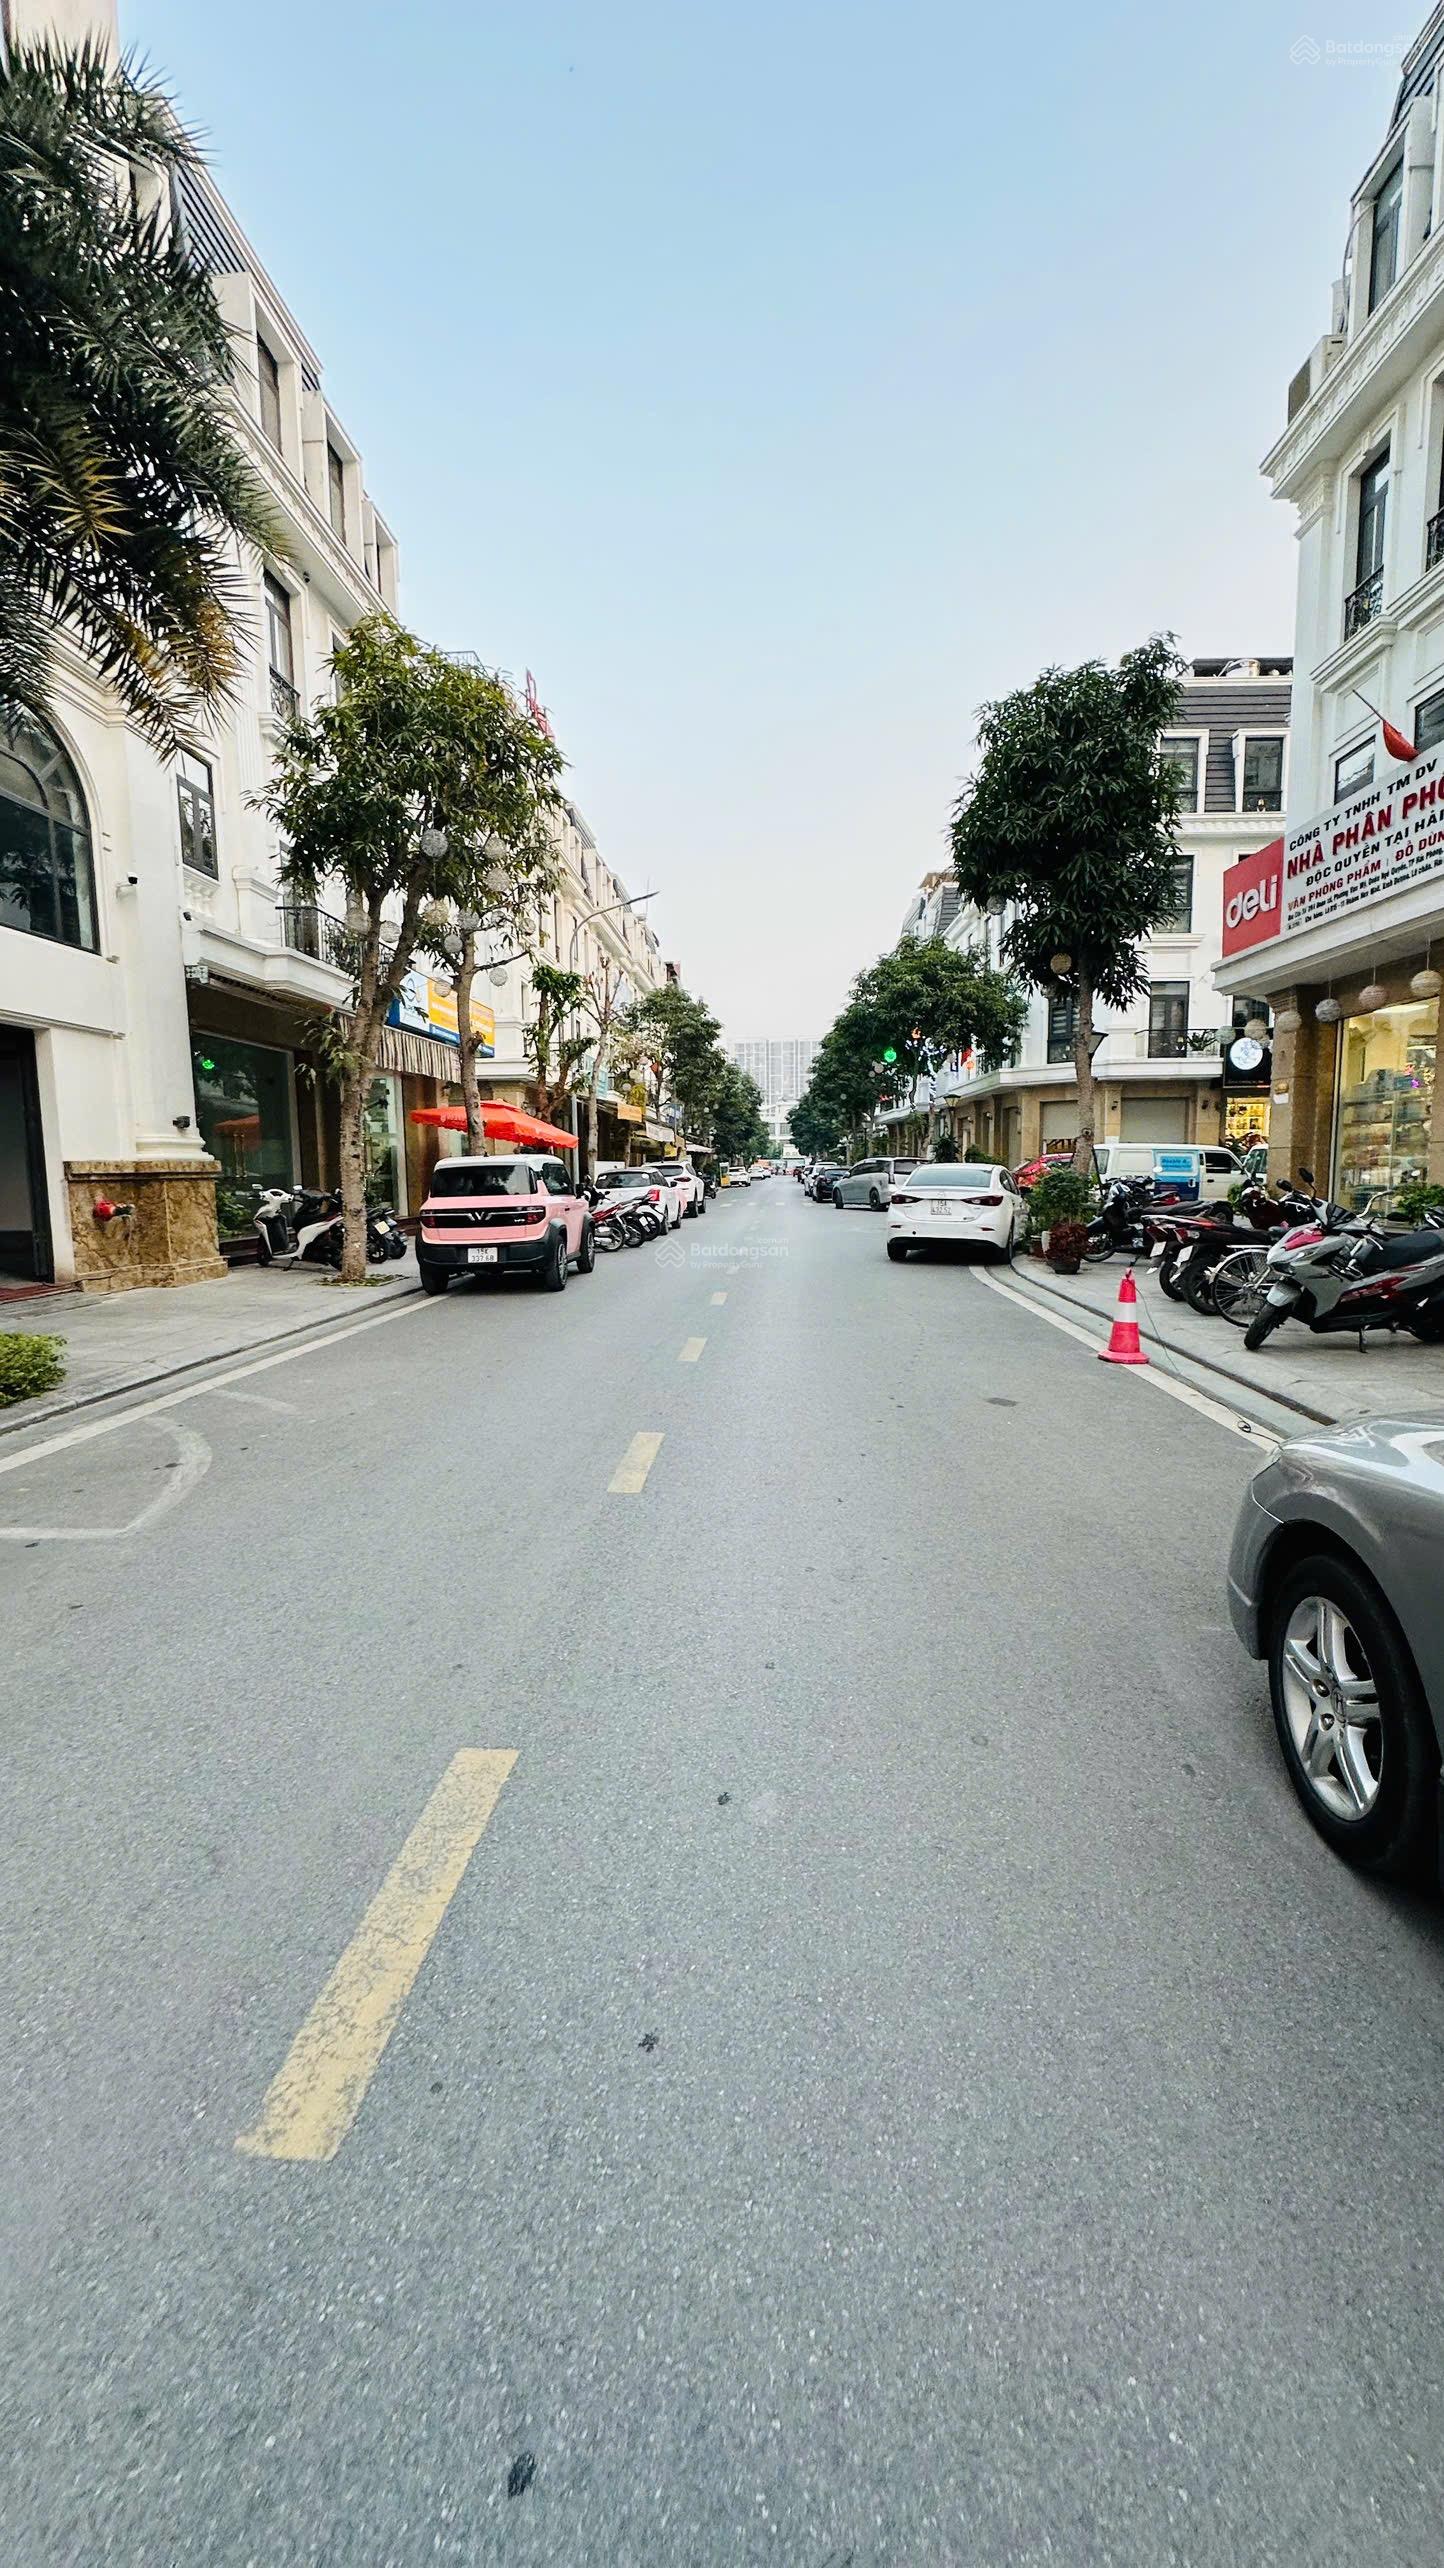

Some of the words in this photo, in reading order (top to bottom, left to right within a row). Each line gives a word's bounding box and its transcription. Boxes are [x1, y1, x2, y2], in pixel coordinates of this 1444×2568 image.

[1289, 826, 1320, 851] CÔNG
[1324, 814, 1341, 831] TY
[1344, 791, 1381, 819] TNHH
[1387, 773, 1411, 795] TM
[1415, 758, 1438, 780] DV
[1384, 826, 1410, 847] TẠI
[1287, 840, 1326, 880] NHÀ
[1332, 804, 1393, 856] PHÂN
[1225, 874, 1278, 929] deli
